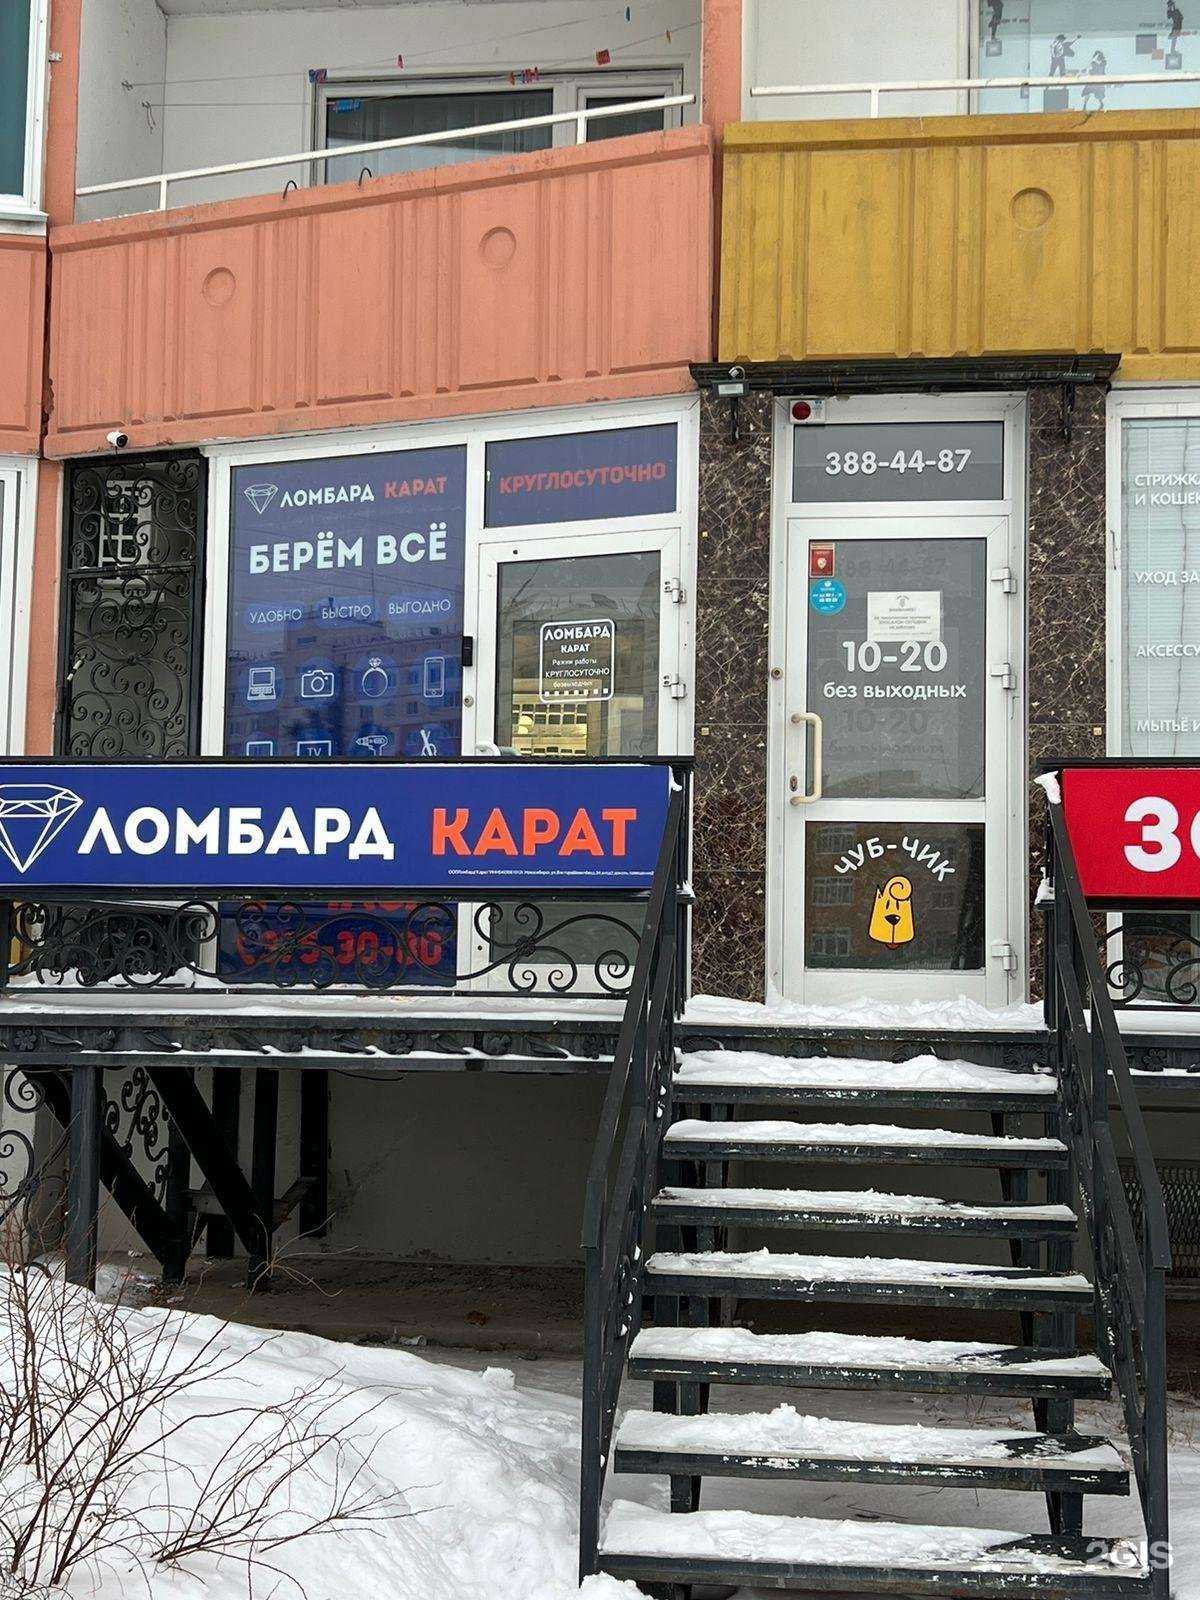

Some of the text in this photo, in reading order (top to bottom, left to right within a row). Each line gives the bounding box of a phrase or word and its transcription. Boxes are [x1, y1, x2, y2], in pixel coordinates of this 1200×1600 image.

[825, 449, 972, 475] 388-44-87
[499, 461, 667, 494] КРУГЛОСУТОЧНО
[1134, 473, 1200, 486] СТРИЖК
[280, 475, 448, 508] ЛОМБАРД КАРАТ
[1135, 493, 1145, 505] И
[249, 521, 447, 574] БЕРЁМ ВСЁ
[1134, 571, 1200, 586] УХОД ЗА
[250, 599, 451, 624] УДОБНО БЫСТРО ВЫГОДНО
[544, 625, 611, 641] ЛОМБАРД
[561, 644, 590, 653] КАРАТ
[842, 640, 948, 672] 10-20
[545, 667, 610, 678] КРУГЛОСУТОЧНО
[823, 682, 967, 700] без выходных
[1137, 716, 1188, 732] МЫТЬЁ
[78, 806, 637, 860] ЛОМБАРД КАРАТ
[1123, 795, 1200, 873] 3
[833, 836, 956, 882] ЧУБ-ЧИК
